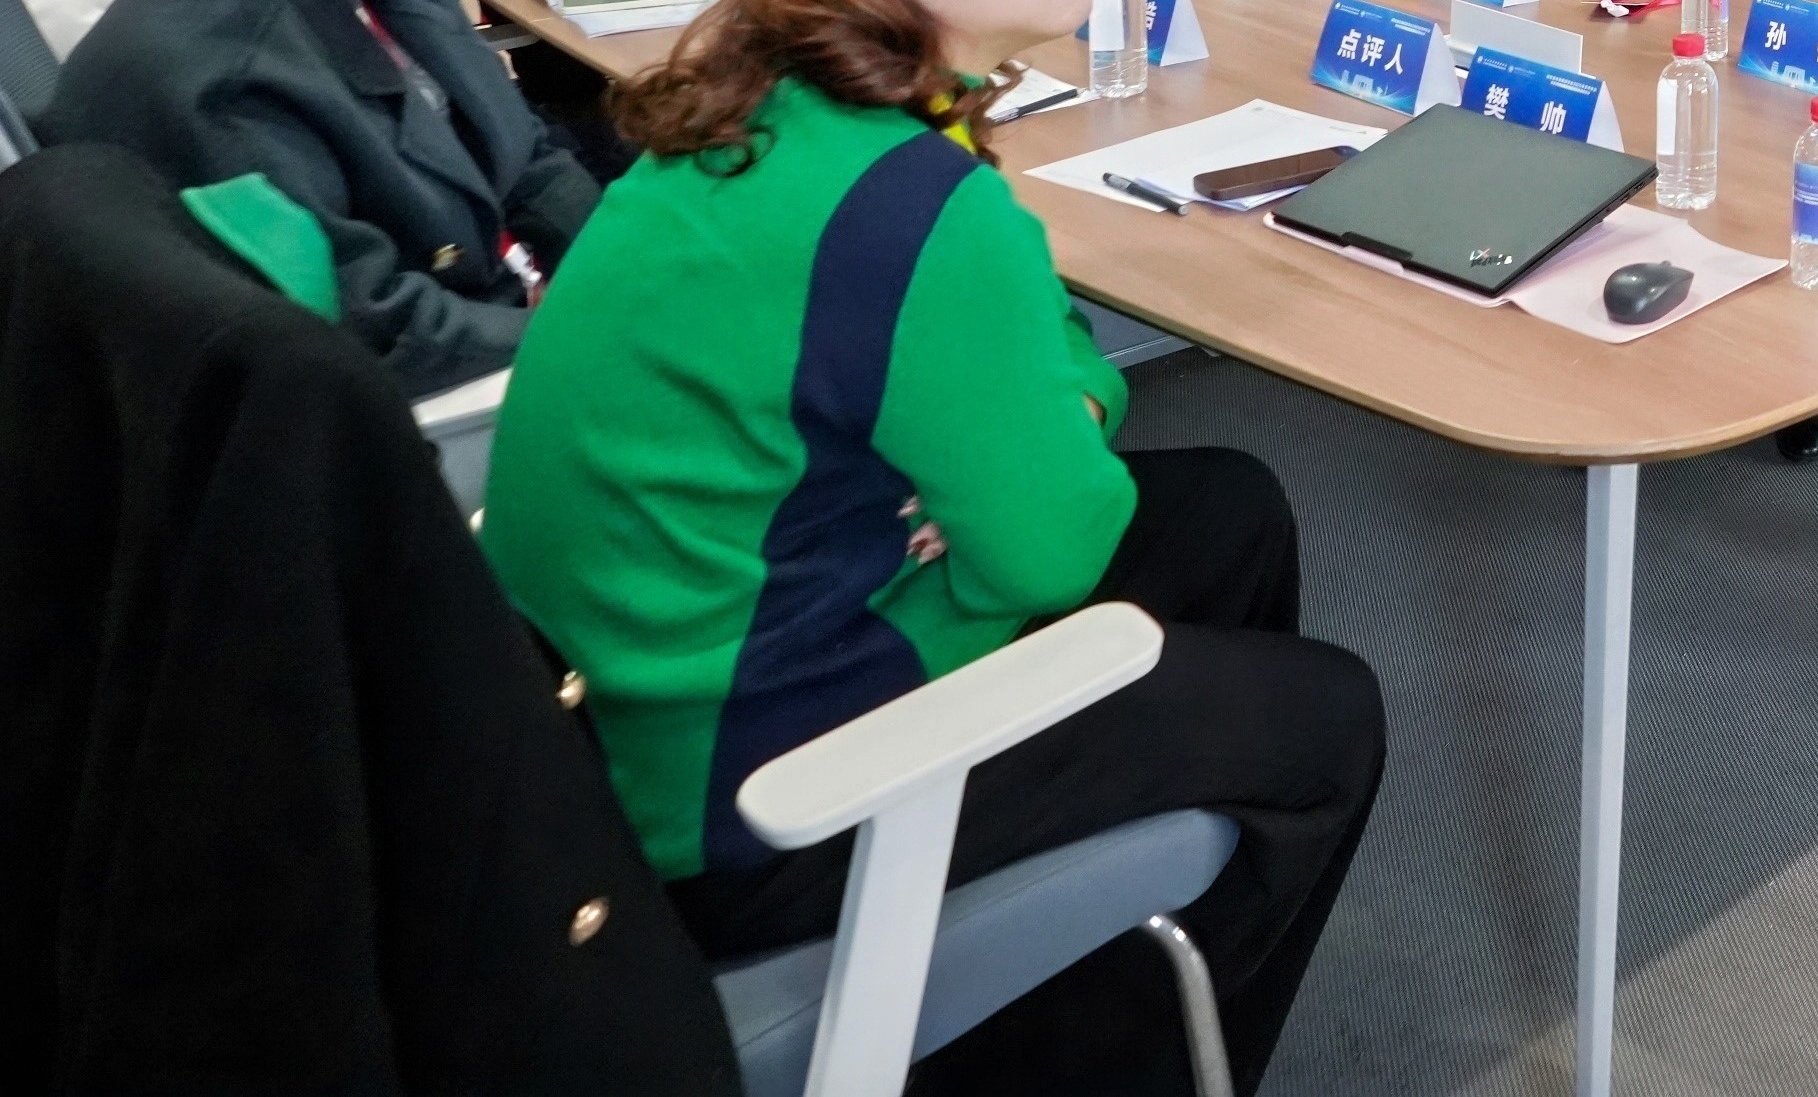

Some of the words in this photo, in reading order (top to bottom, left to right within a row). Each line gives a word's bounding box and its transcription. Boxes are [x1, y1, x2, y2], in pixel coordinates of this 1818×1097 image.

[1337, 28, 1404, 76] 点评人
[1483, 83, 1567, 135] 樊帅
